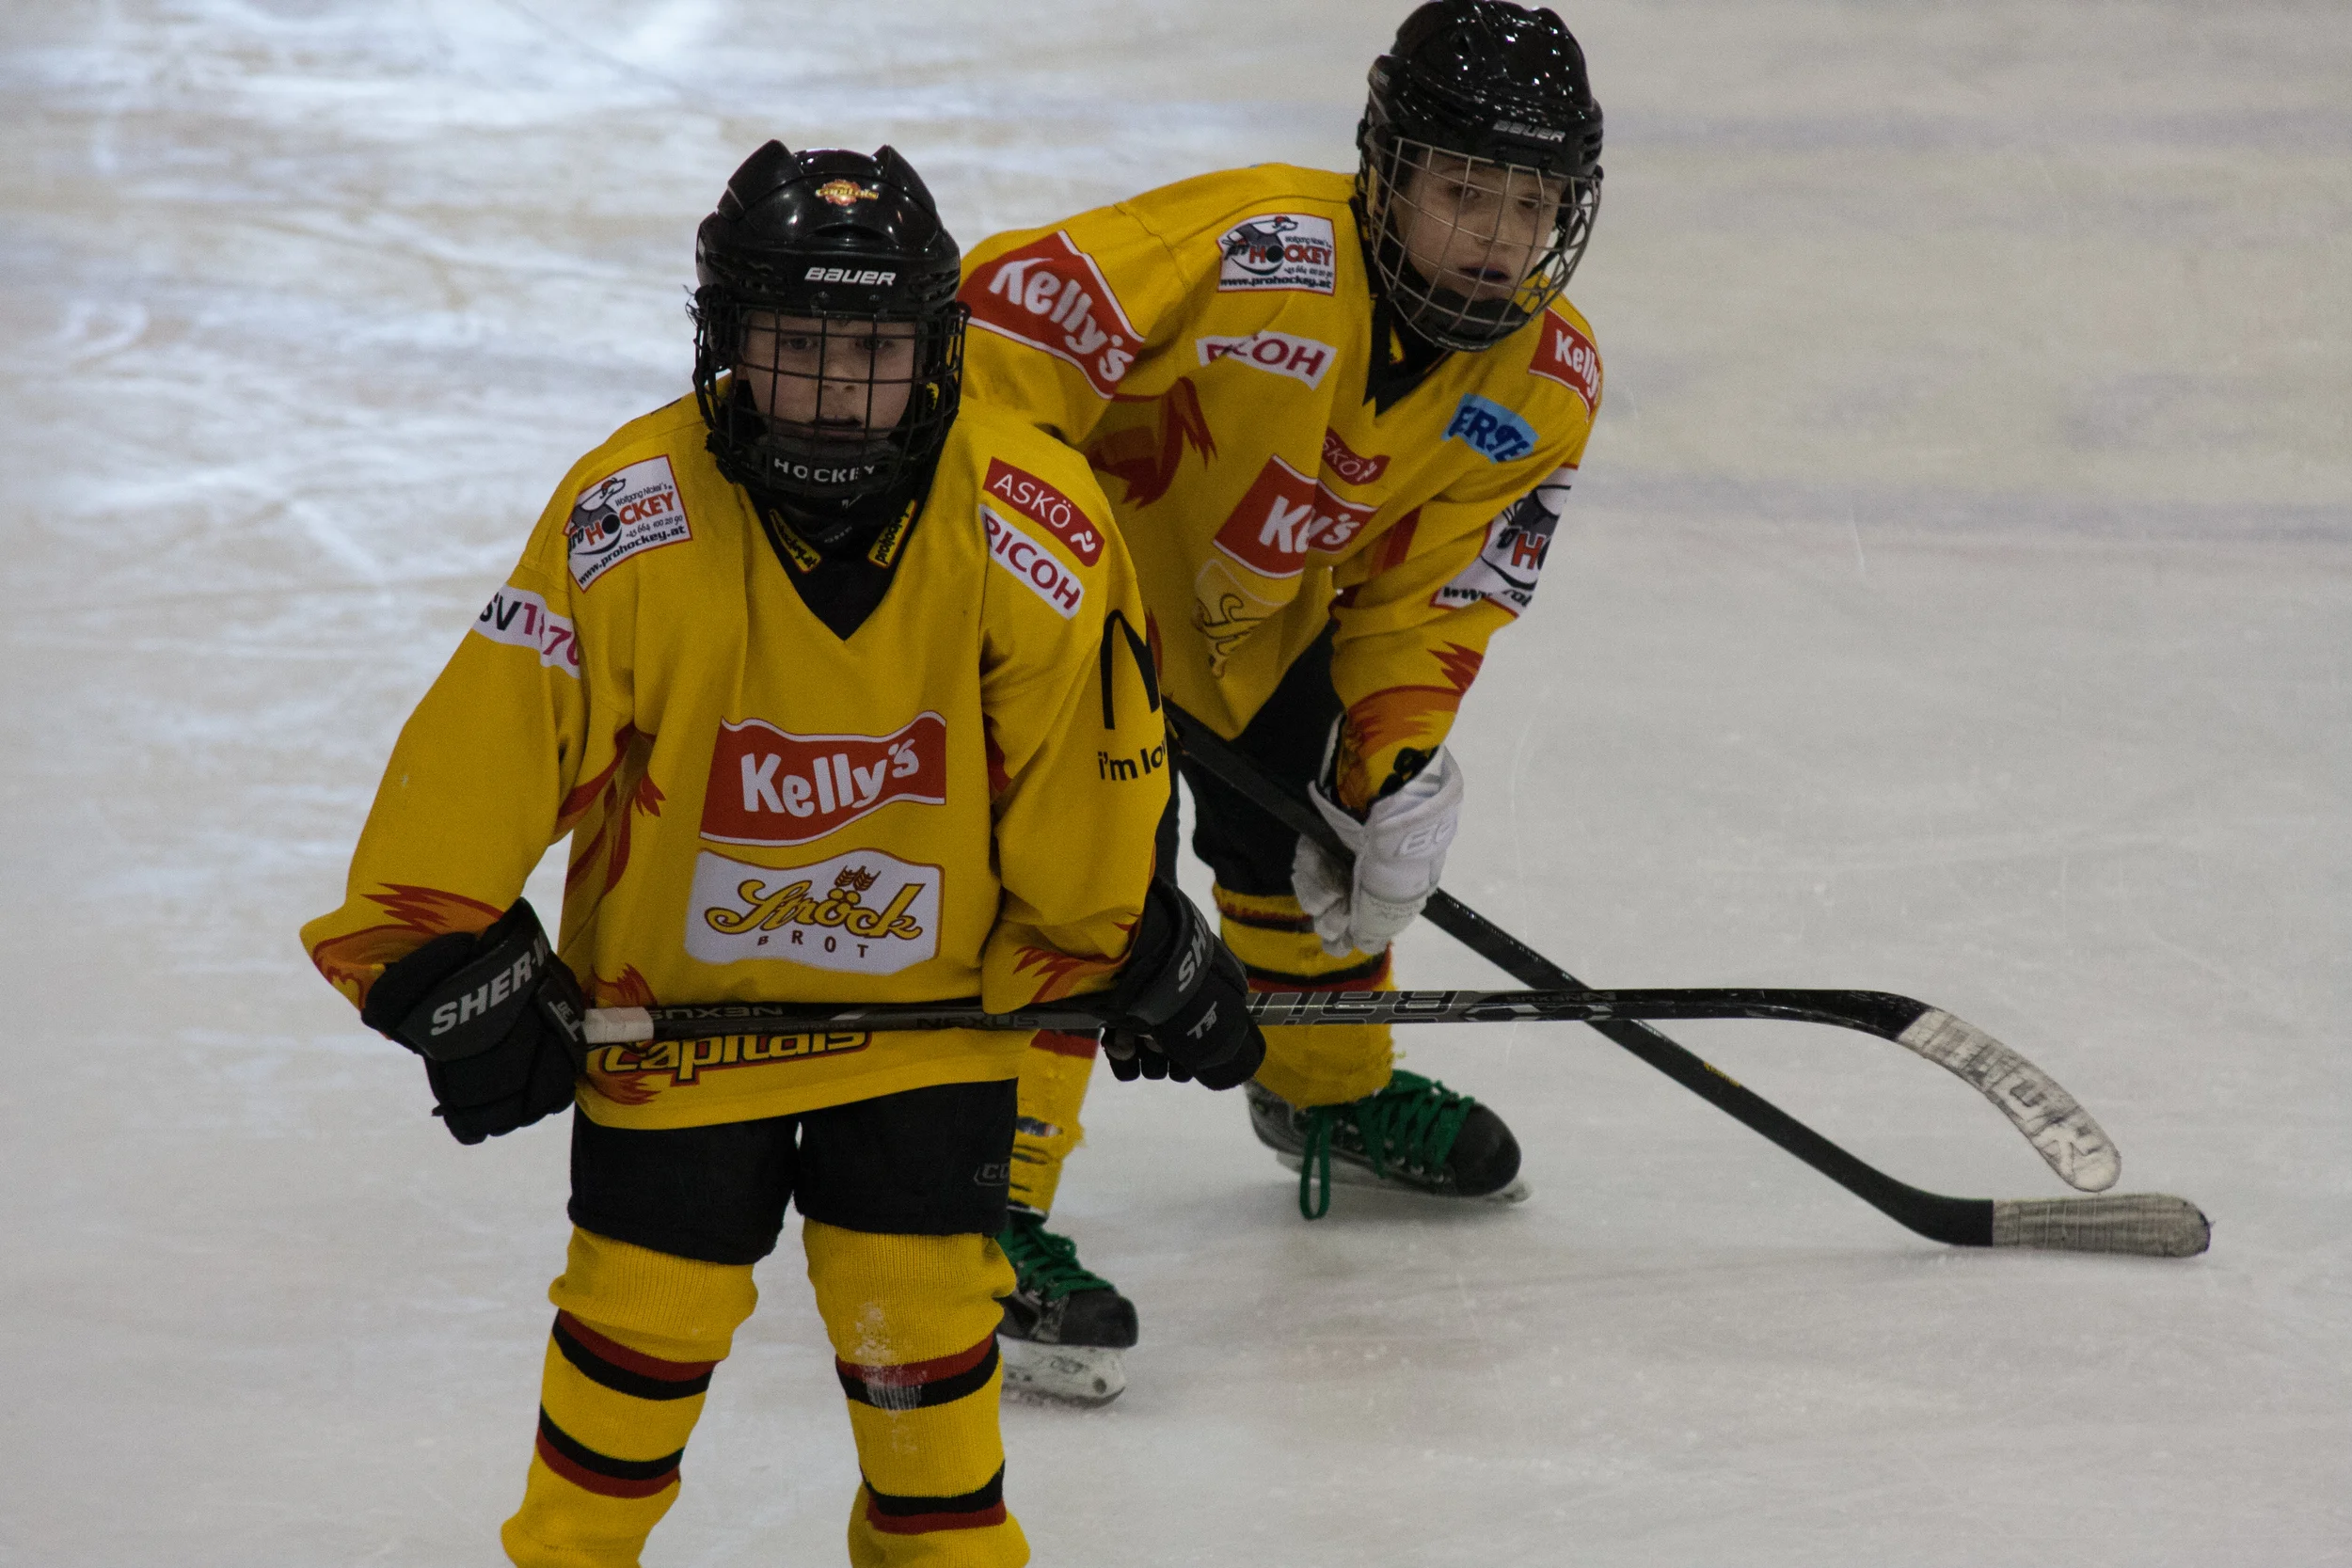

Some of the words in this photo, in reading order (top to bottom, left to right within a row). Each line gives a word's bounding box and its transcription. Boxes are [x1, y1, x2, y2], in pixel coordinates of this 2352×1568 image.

[804, 267, 897, 286] BAUER
[1555, 329, 1599, 399] Kelly
[774, 458, 875, 483] HOCKEY
[993, 473, 1072, 529] ASKÖ
[579, 526, 687, 585] www.prohockey.at
[985, 512, 1081, 610] RICOH
[740, 738, 920, 817] Kelly's
[1098, 751, 1138, 781] i'm
[1140, 740, 1167, 775] lo
[705, 879, 927, 941] Ströck
[757, 929, 869, 958] BROT
